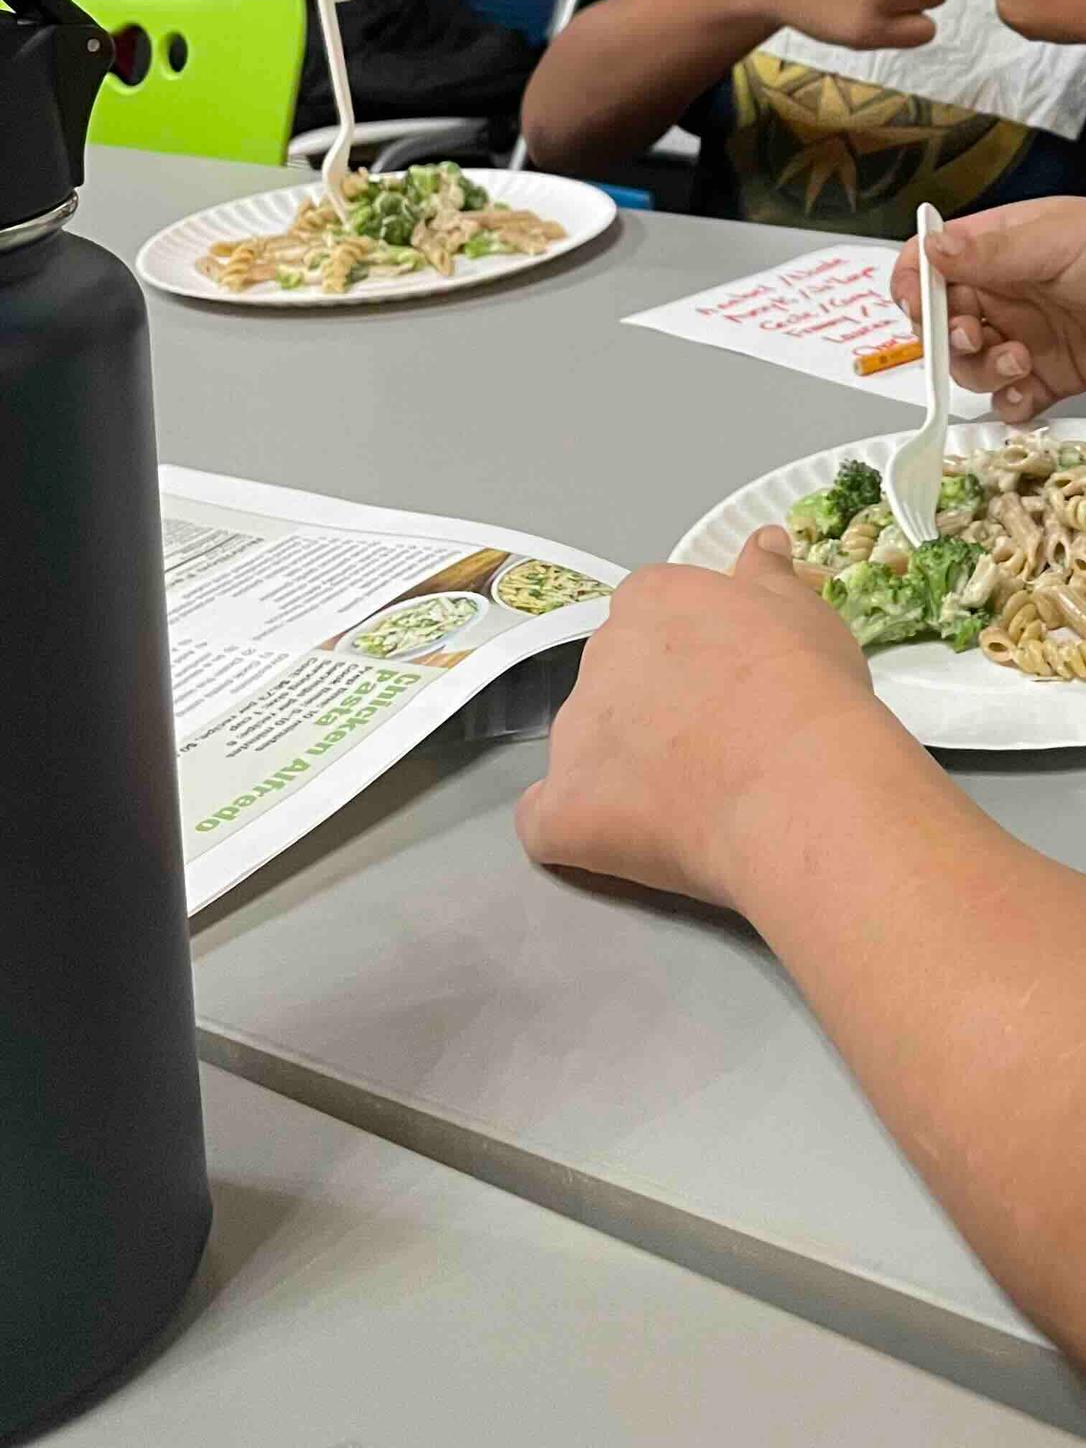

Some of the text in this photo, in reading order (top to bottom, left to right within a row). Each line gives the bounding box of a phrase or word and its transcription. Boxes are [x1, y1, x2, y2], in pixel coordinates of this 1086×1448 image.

[313, 669, 398, 726] Pasta
[195, 673, 421, 832] Chicken Alfredo
